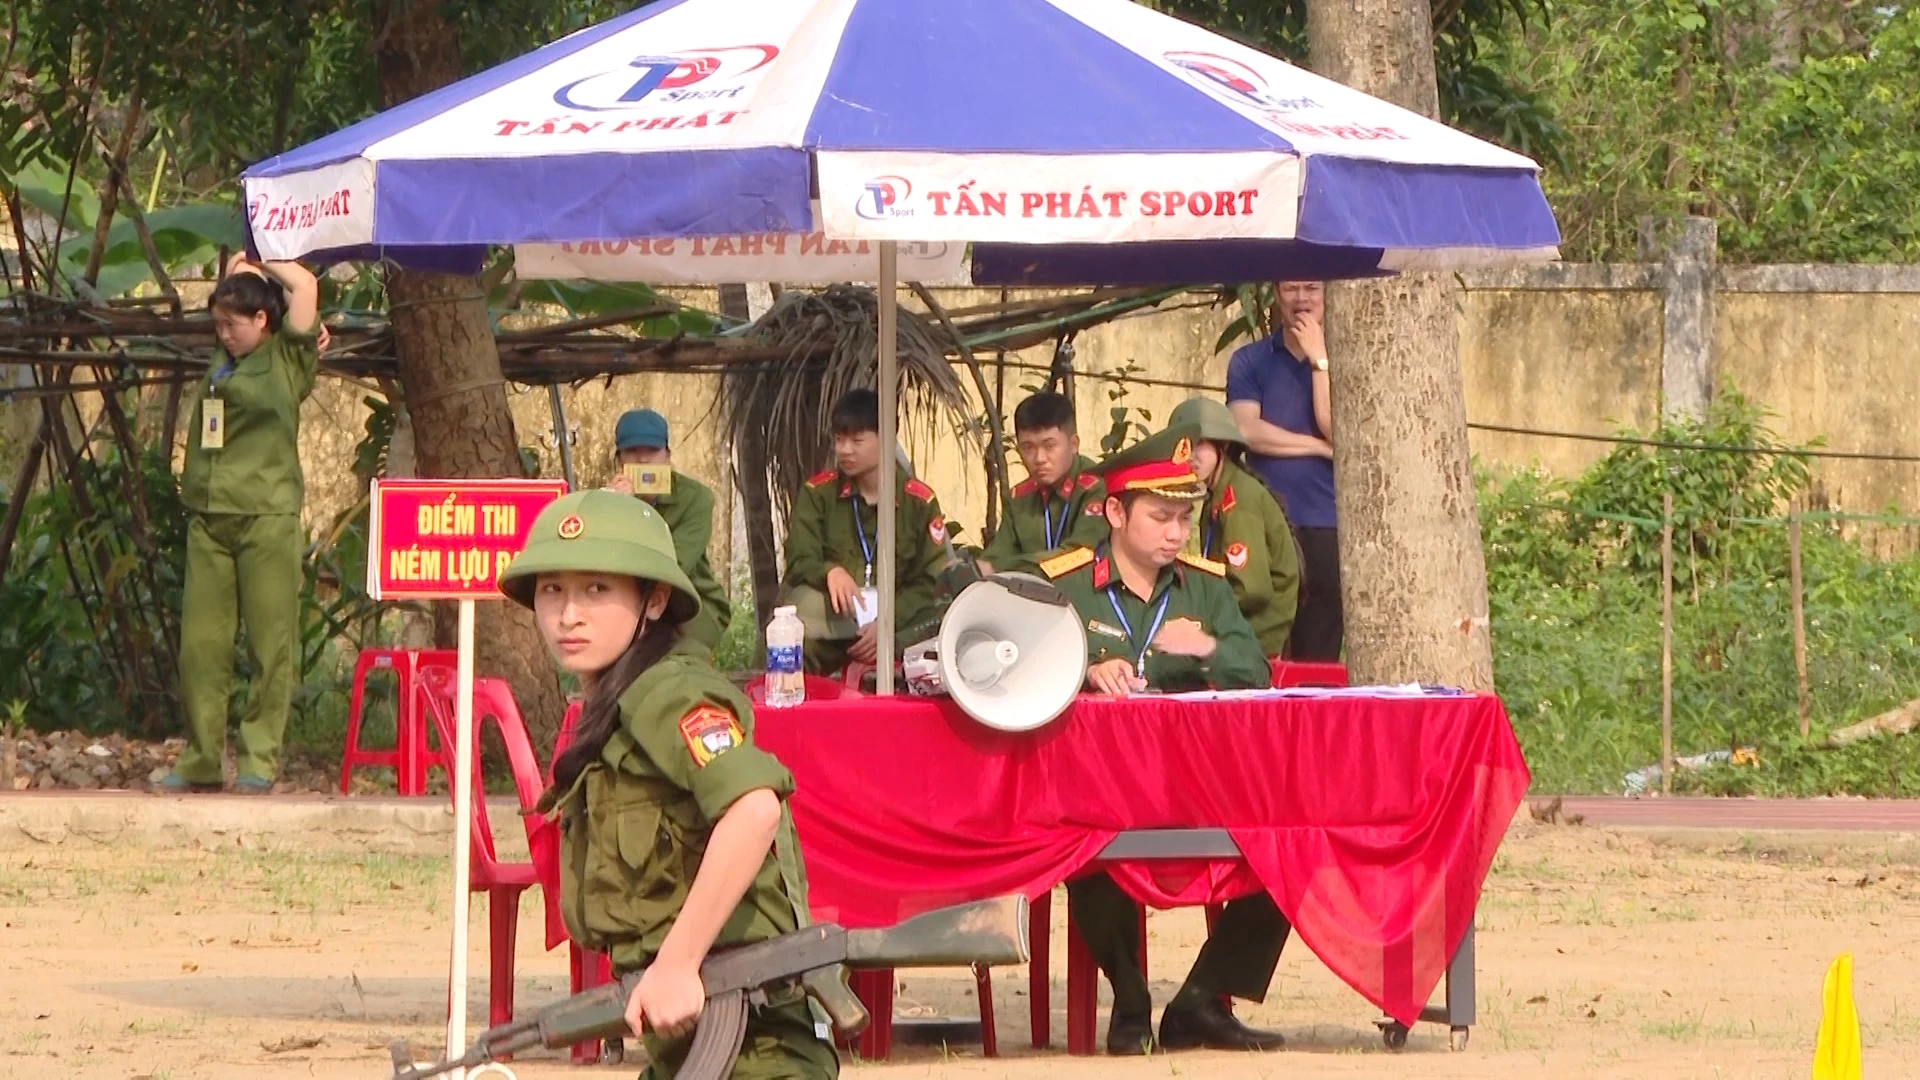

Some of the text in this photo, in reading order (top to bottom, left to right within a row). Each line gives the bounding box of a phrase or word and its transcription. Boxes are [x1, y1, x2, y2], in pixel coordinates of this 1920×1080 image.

[660, 86, 745, 103] Sport
[493, 109, 751, 136] TẤN PHÁT
[926, 179, 1259, 218] TẤN PHÁT SPORT
[418, 492, 516, 536] ĐIỂM THI
[390, 543, 441, 581] NÉM
[447, 547, 490, 588] LỰU
